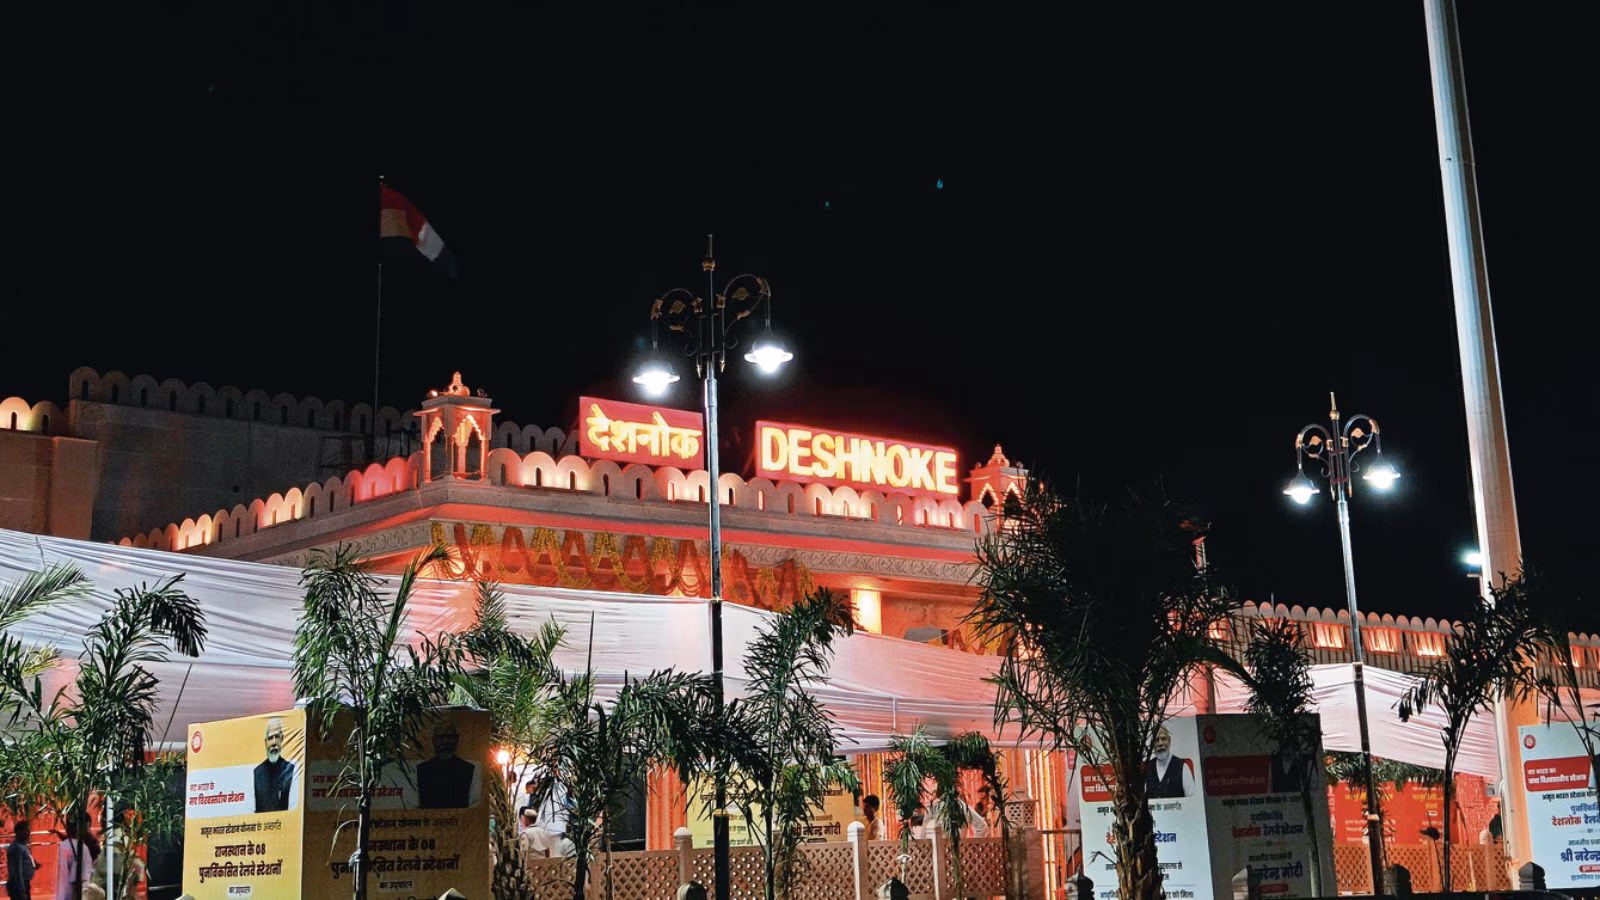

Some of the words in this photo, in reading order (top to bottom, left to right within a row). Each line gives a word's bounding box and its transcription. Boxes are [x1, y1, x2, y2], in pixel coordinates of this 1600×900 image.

[585, 403, 702, 459] देशनोक
[760, 427, 959, 494] DESHNOKE
[824, 821, 841, 835] मोदी
[1552, 815, 1581, 826] देशनोक
[408, 835, 419, 851] के
[1152, 831, 1177, 843] स्टेशन
[215, 844, 247, 857] राजस्थान
[247, 840, 255, 855] के
[255, 843, 266, 855] 08
[1560, 848, 1573, 862] श्री
[199, 861, 238, 884] पुनर्विकसित
[239, 860, 256, 877] रेलवे
[256, 858, 283, 876] स्टेशनों
[396, 855, 420, 872] रेलवे
[1281, 861, 1304, 879] मोदी
